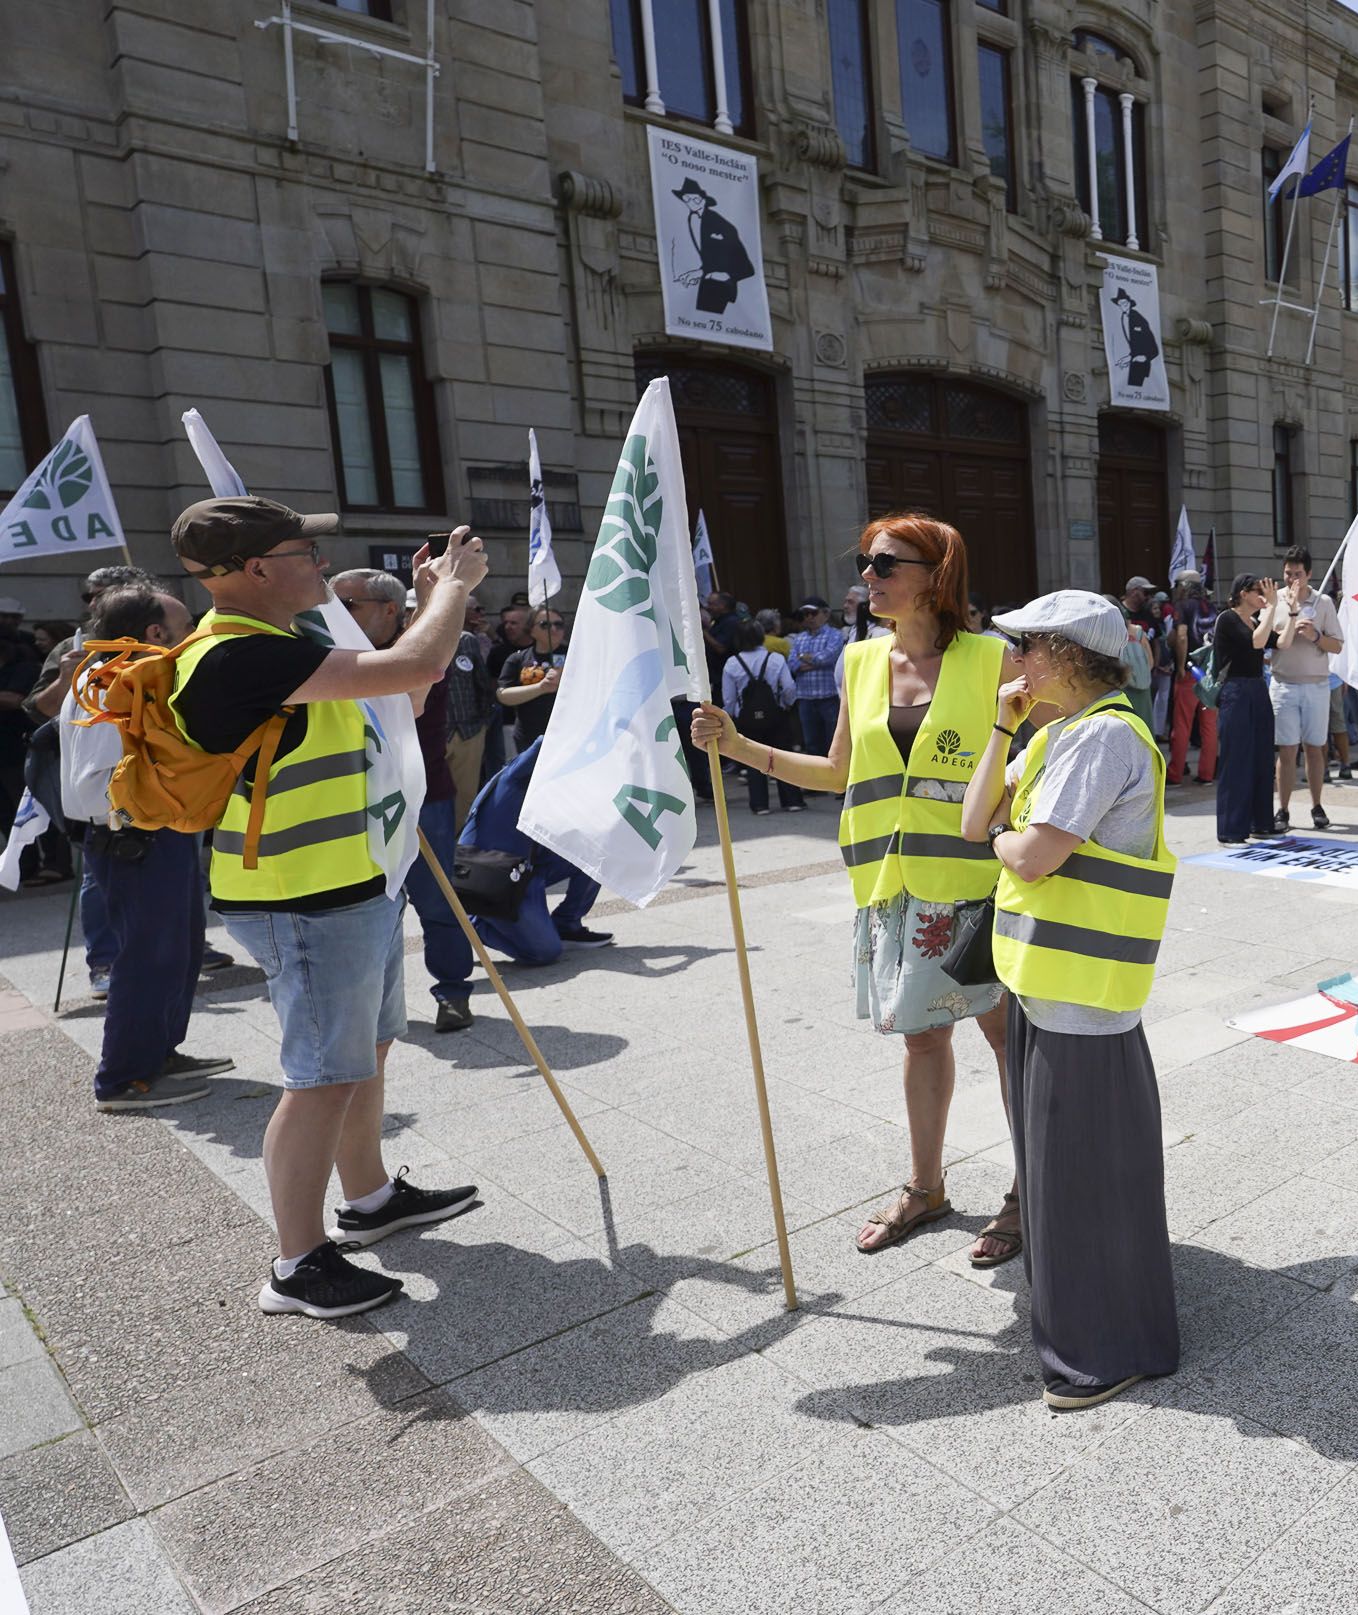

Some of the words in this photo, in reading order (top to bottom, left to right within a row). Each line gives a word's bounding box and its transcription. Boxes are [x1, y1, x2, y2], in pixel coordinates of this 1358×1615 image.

[661, 139, 681, 152] IES
[684, 145, 747, 171] Valle-Inclán
[681, 159, 706, 173] noso
[678, 316, 690, 326] No
[693, 320, 707, 329] seu
[709, 320, 722, 332] 75
[930, 754, 974, 769] ADEGA
[1228, 850, 1290, 862] NIN
